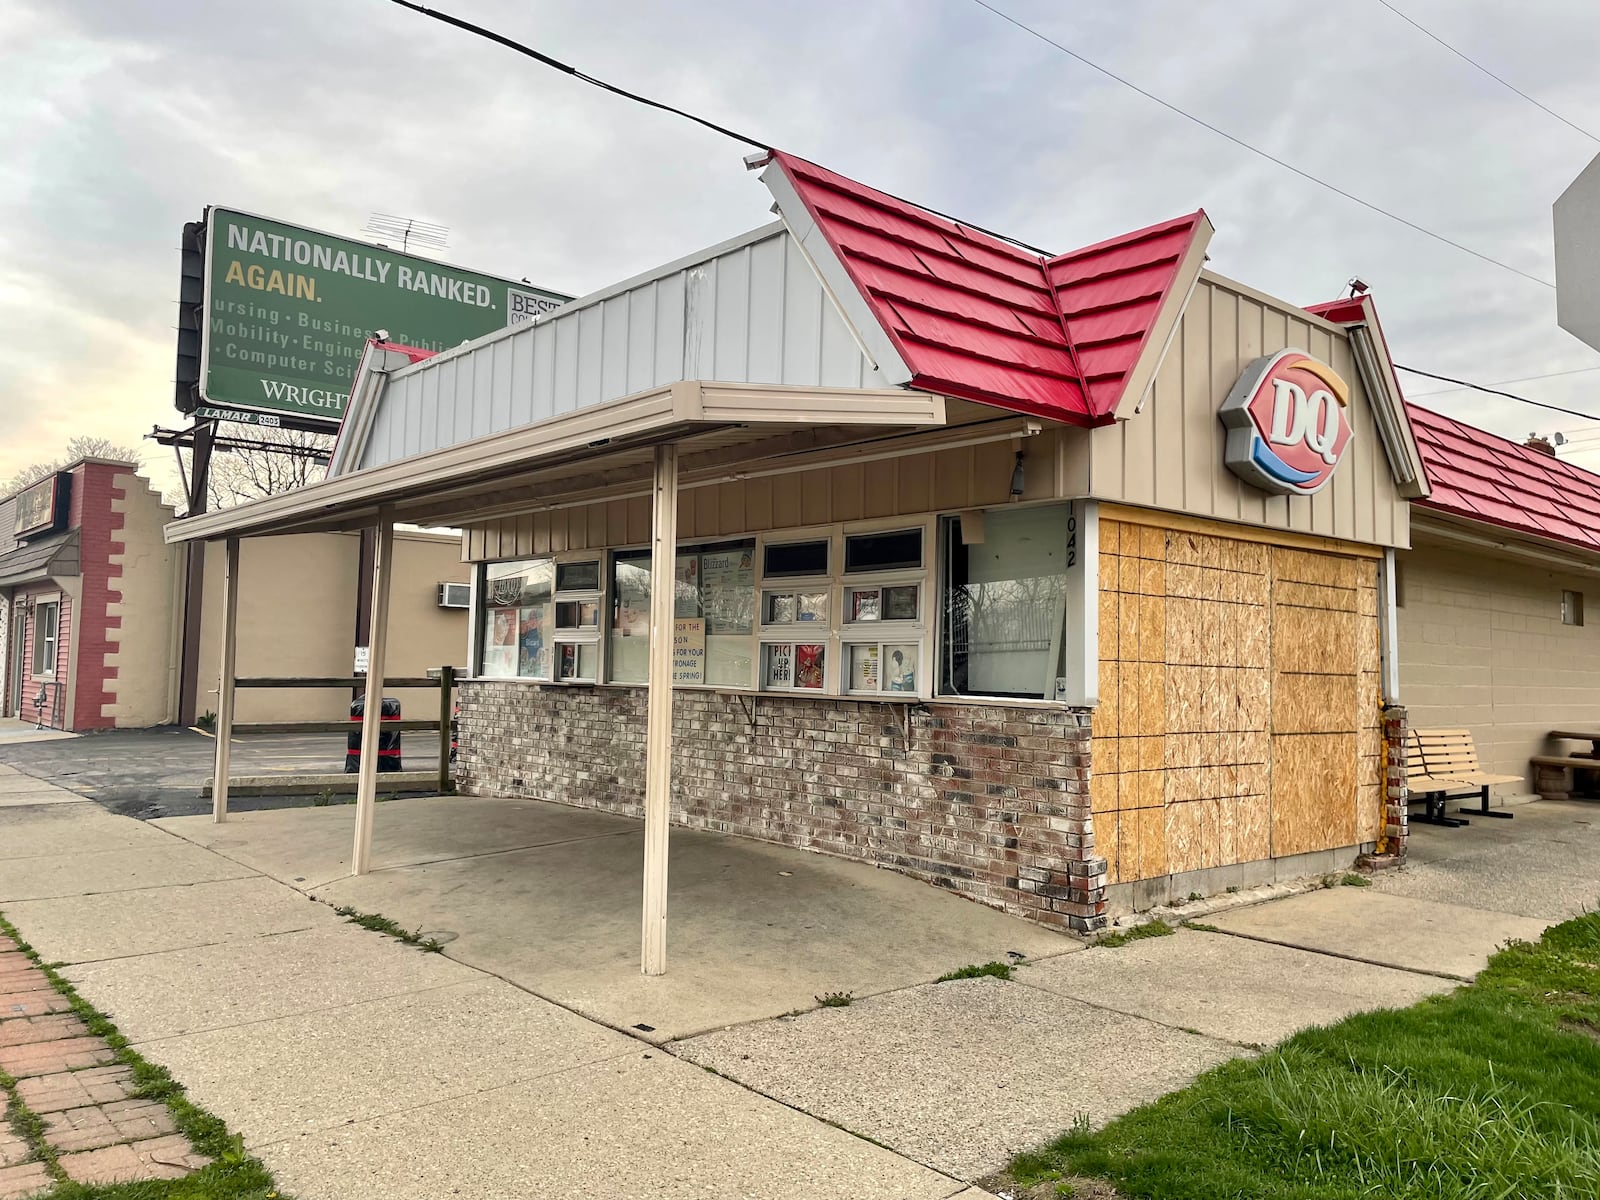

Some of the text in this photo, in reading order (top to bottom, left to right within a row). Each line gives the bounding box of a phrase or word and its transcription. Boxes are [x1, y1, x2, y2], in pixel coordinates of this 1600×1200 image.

[225, 260, 322, 303] AGAIN.
[228, 223, 496, 310] NATIONALLY RANKED.
[211, 317, 289, 348] Mobility
[298, 312, 374, 340] Busines
[400, 333, 451, 352] Publi
[226, 343, 357, 379] Computer Sci
[203, 408, 251, 422] LAMAR
[1269, 378, 1339, 465] DQ
[703, 556, 729, 570] Blizzard
[675, 623, 700, 631] FOR THE
[676, 648, 687, 656] FOR
[688, 648, 704, 656] YOUR
